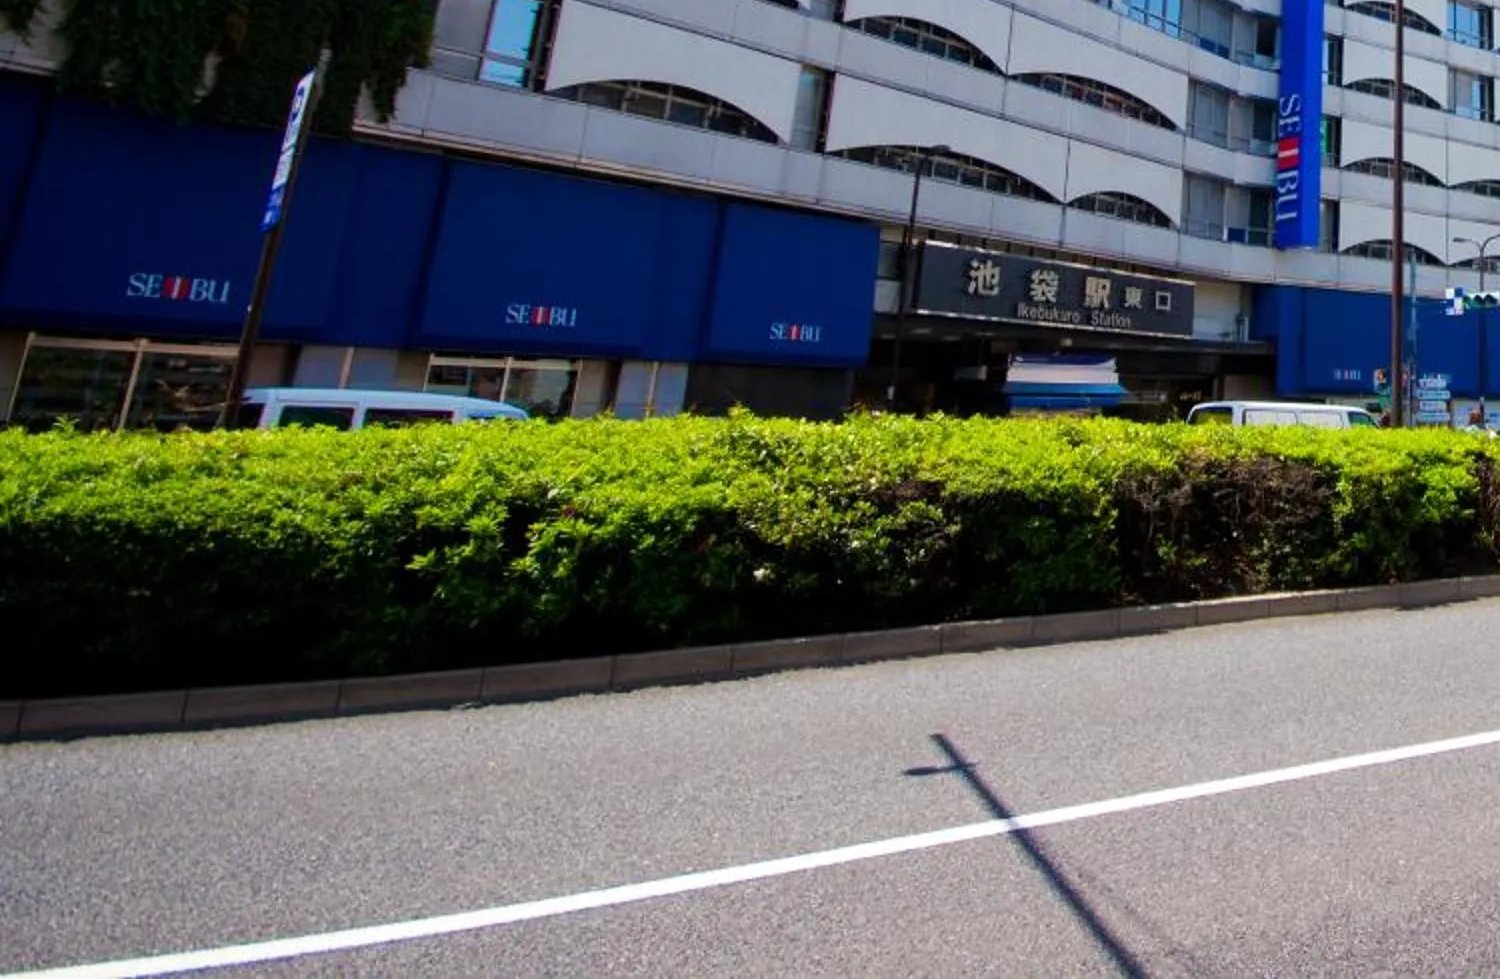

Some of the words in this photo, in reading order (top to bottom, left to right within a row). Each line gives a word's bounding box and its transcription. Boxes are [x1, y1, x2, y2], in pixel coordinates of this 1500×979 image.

[1276, 94, 1301, 221] SEIBU
[125, 272, 230, 303] SEIBU
[966, 257, 1172, 312] 池袋駅東口
[504, 303, 578, 327] SEIBU
[1017, 301, 1081, 324] Ikebukuro
[1091, 308, 1132, 328] Station
[768, 321, 822, 343] SEIBU
